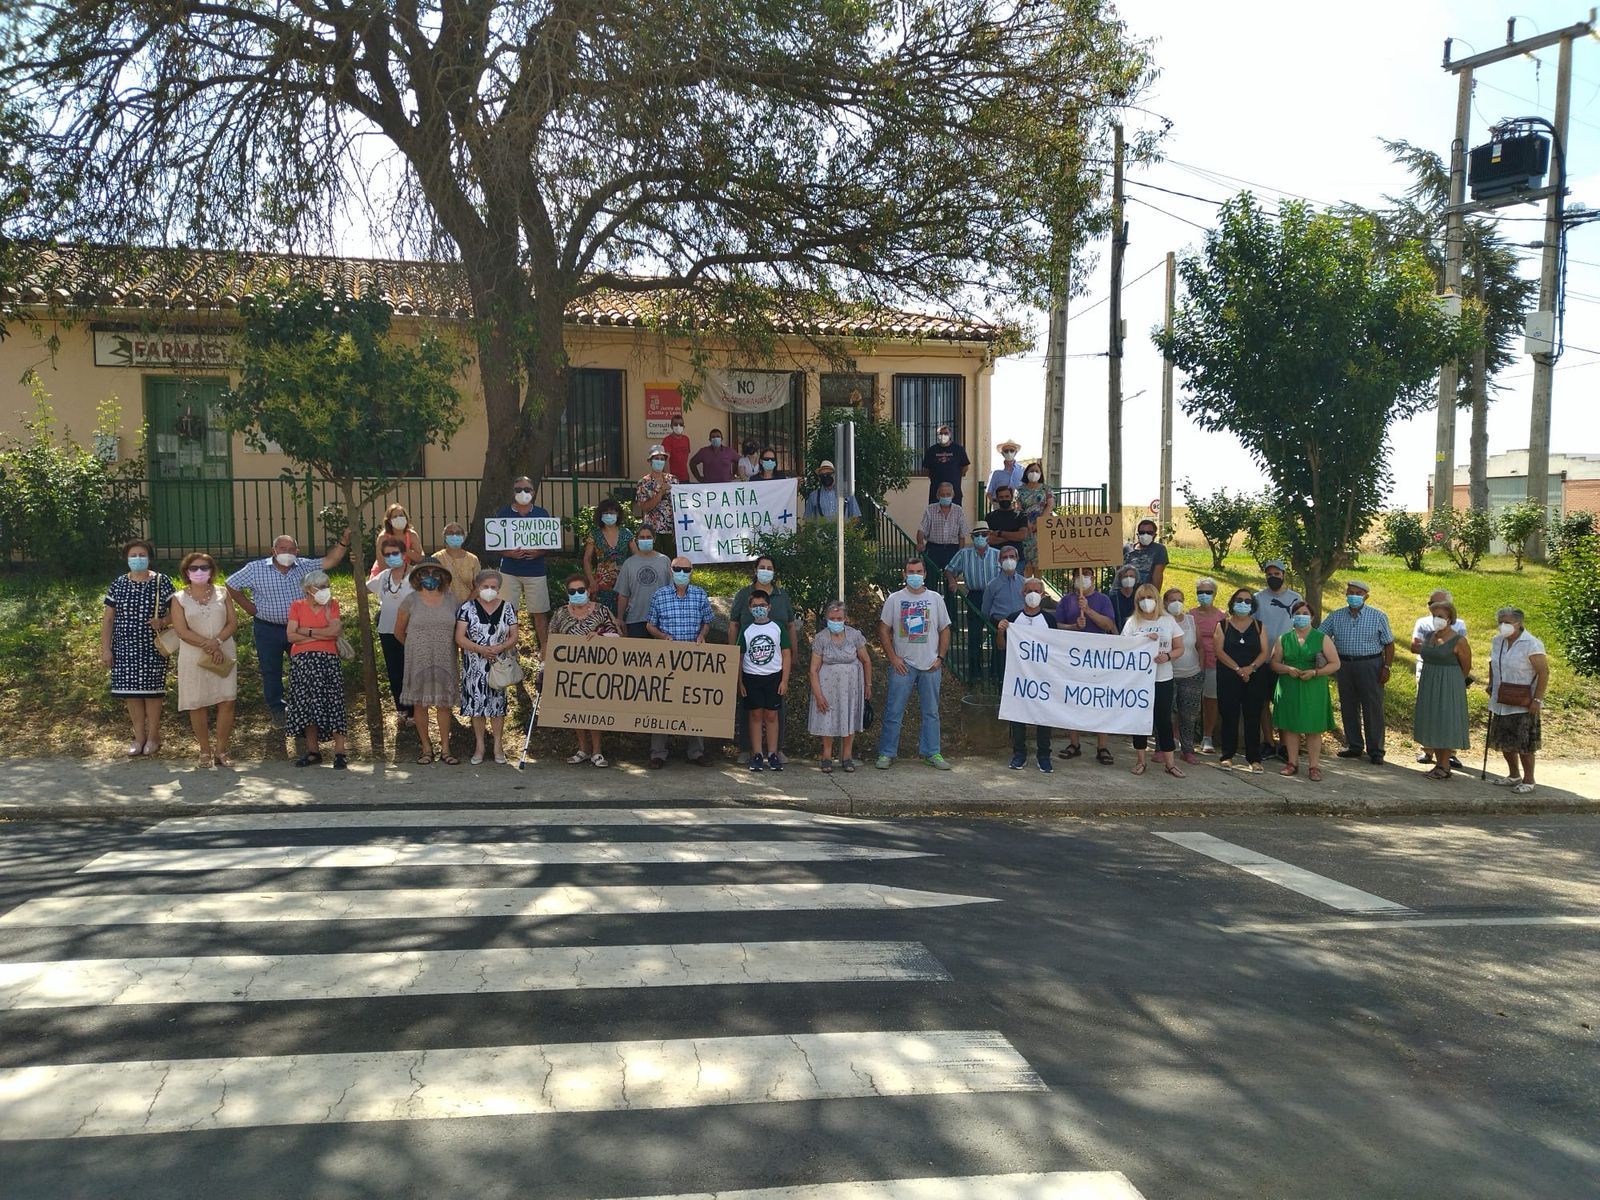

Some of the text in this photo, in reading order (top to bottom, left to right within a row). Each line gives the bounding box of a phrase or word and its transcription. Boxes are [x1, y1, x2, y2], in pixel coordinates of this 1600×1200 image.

[134, 340, 228, 360] FARMAC
[737, 380, 755, 394] NO
[511, 519, 560, 531] SANIDAD
[704, 510, 772, 529] VACIADA
[1046, 515, 1113, 528] SANIDAD
[513, 531, 558, 547] PÚBLICA
[1050, 527, 1110, 539] PÚBLICA
[681, 535, 703, 552] DE
[553, 645, 727, 674] CUANDO VAYA A VOTAR
[1019, 640, 1049, 663] SIN
[554, 670, 724, 706] RECORDARÉ ESTO
[1013, 677, 1149, 709] NOS MORIMOS
[563, 712, 615, 726] SANIDAD
